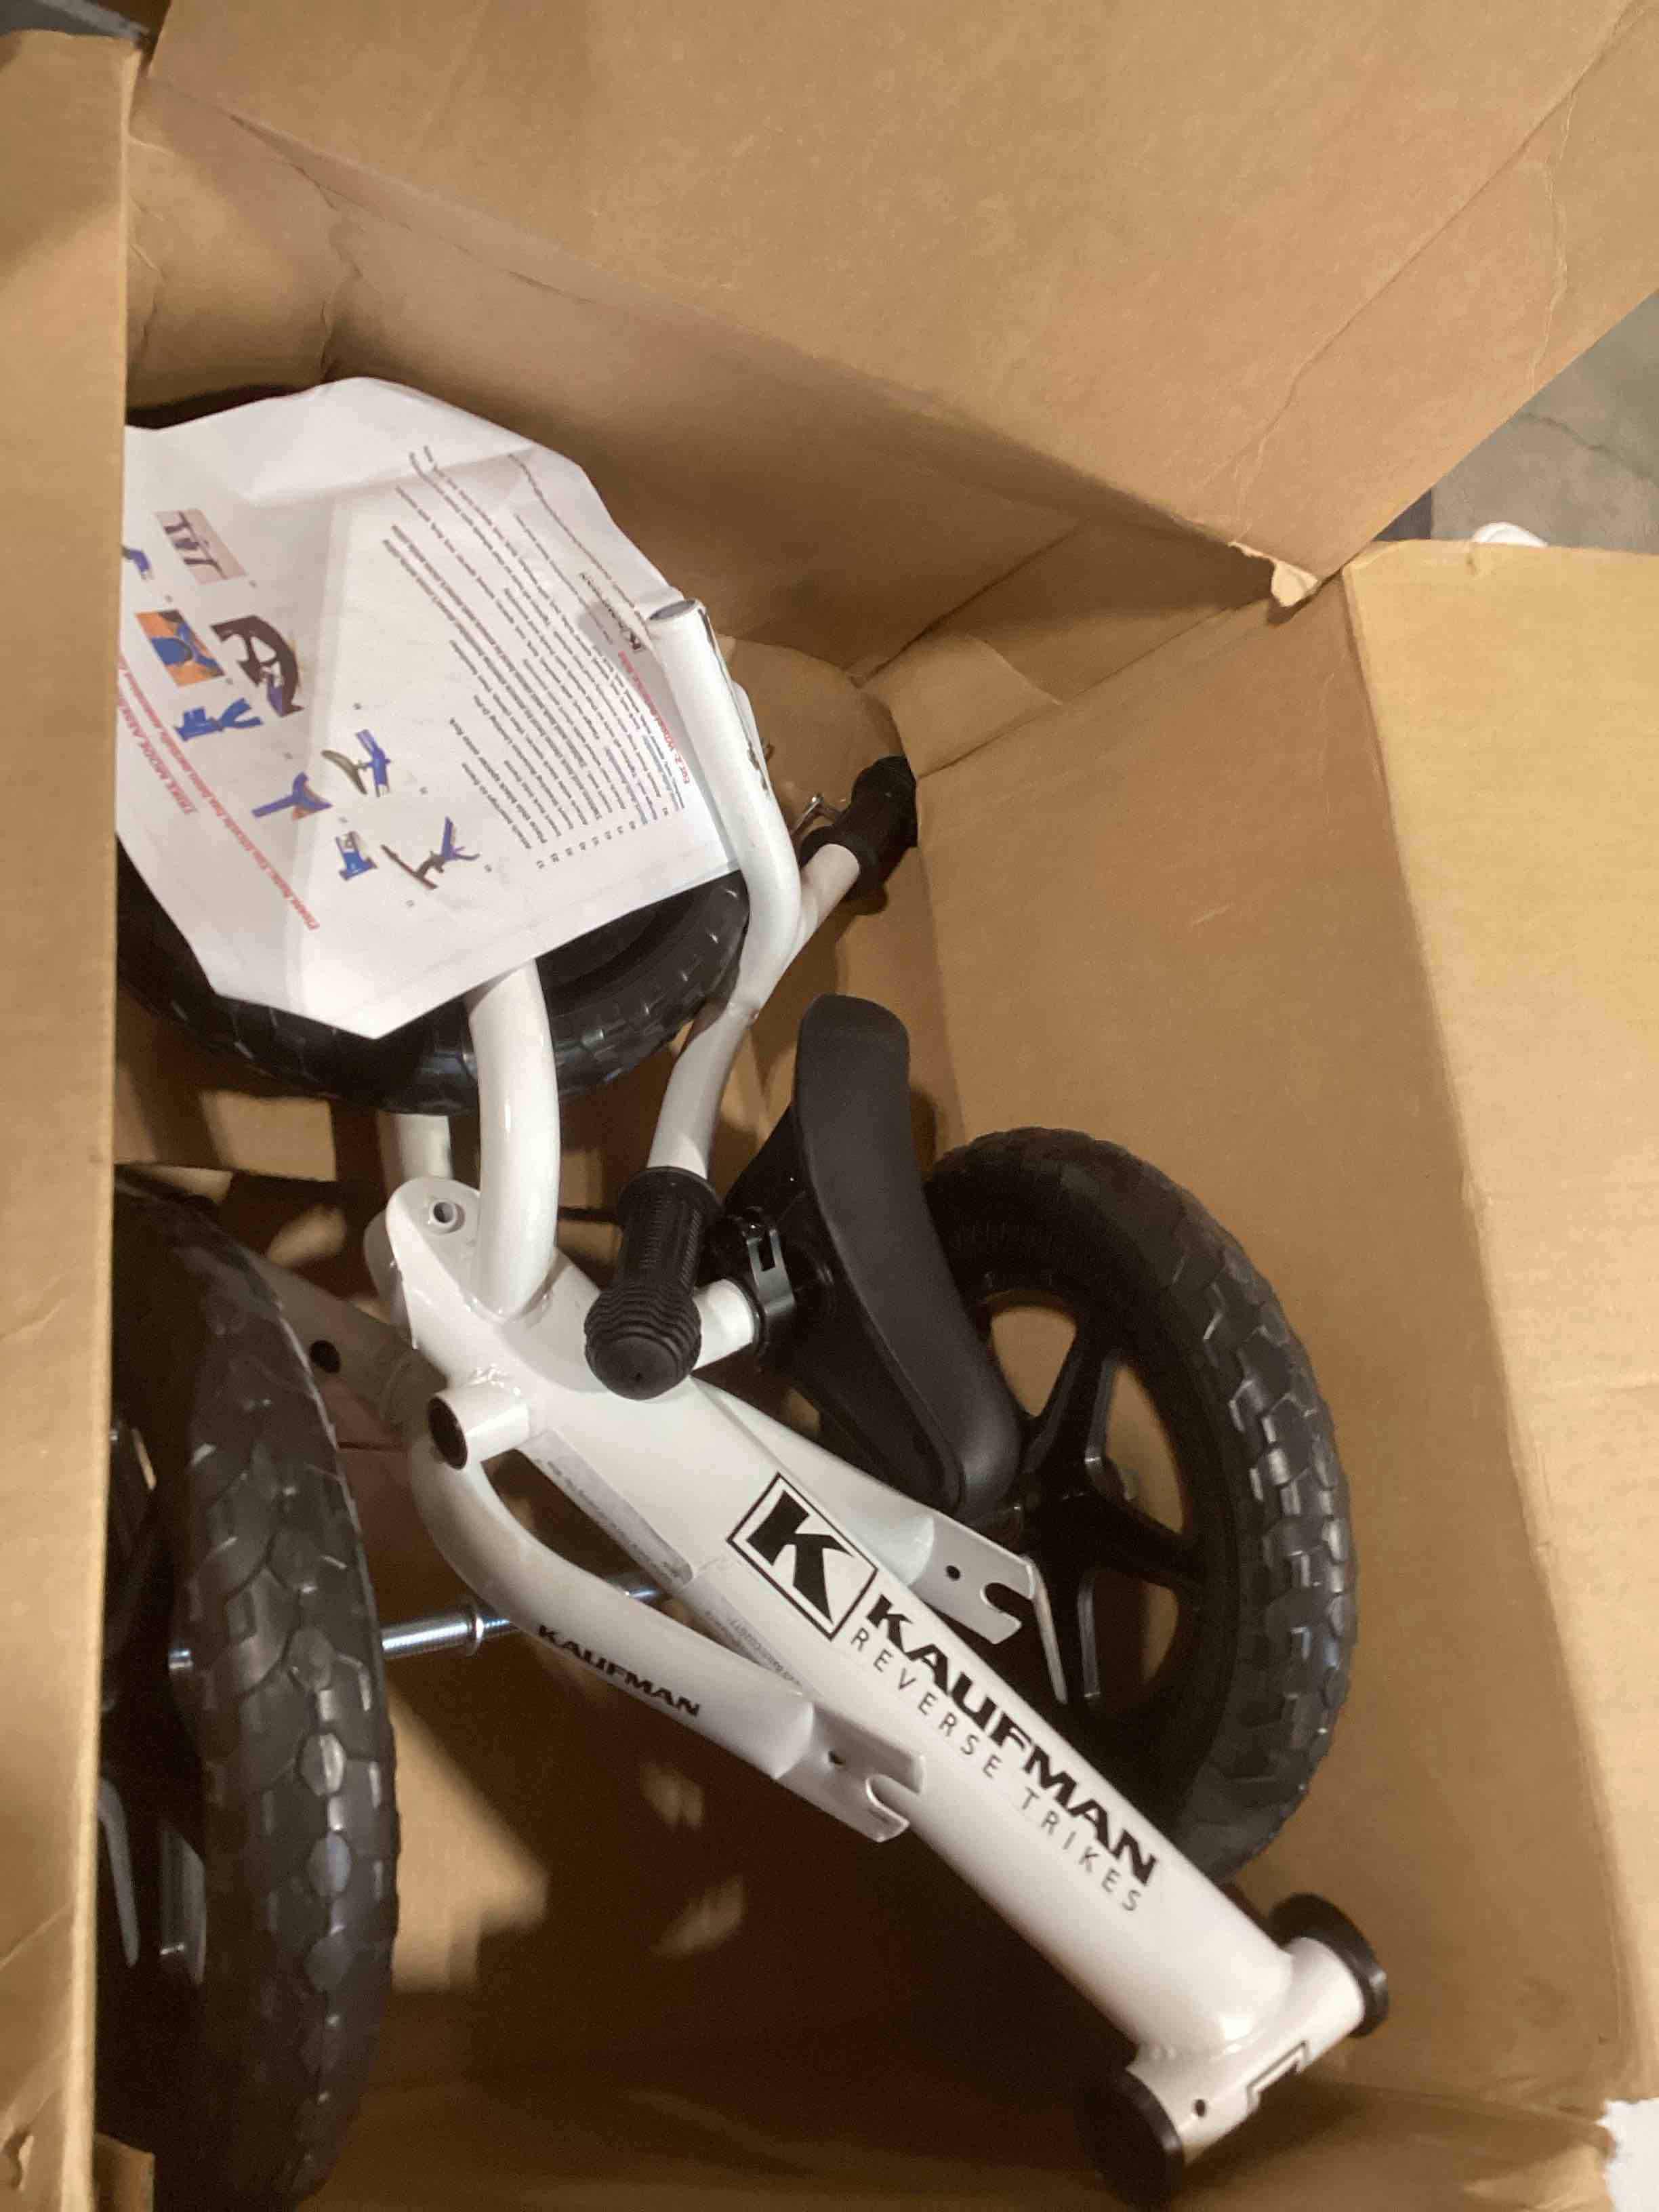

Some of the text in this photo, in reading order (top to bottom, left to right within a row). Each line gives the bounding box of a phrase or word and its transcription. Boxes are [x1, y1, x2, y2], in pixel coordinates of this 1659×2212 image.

[745, 1490, 859, 1623] K
[539, 1625, 701, 1717] KAUFMAN
[850, 1628, 1003, 1780] REVERSE
[1022, 1786, 1143, 1912] TRIKES
[865, 1593, 1158, 1887] KAUFMAN
